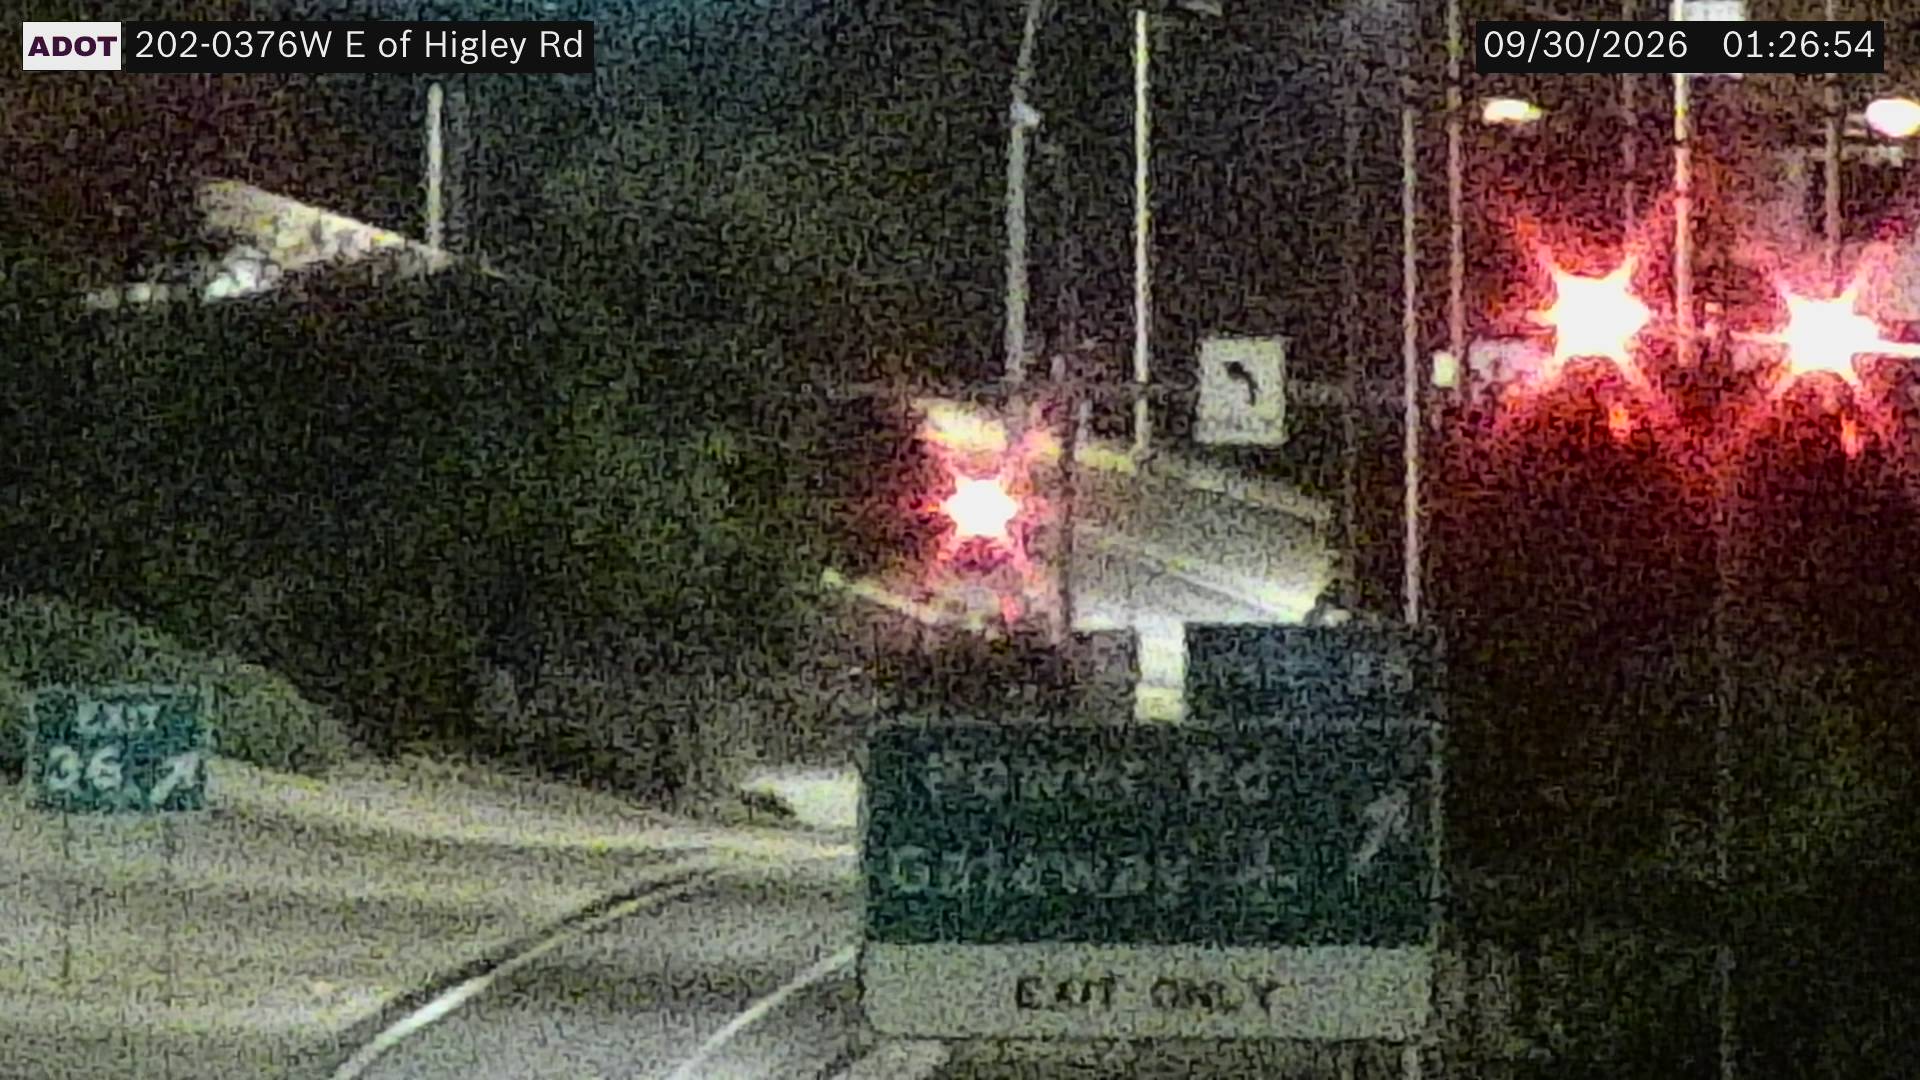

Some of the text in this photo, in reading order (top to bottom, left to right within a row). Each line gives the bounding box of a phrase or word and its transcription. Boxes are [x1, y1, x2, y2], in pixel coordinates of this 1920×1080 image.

[76, 700, 161, 733] EXIT
[49, 745, 123, 792] 36
[1015, 974, 1278, 1010] EXIT ONLY
